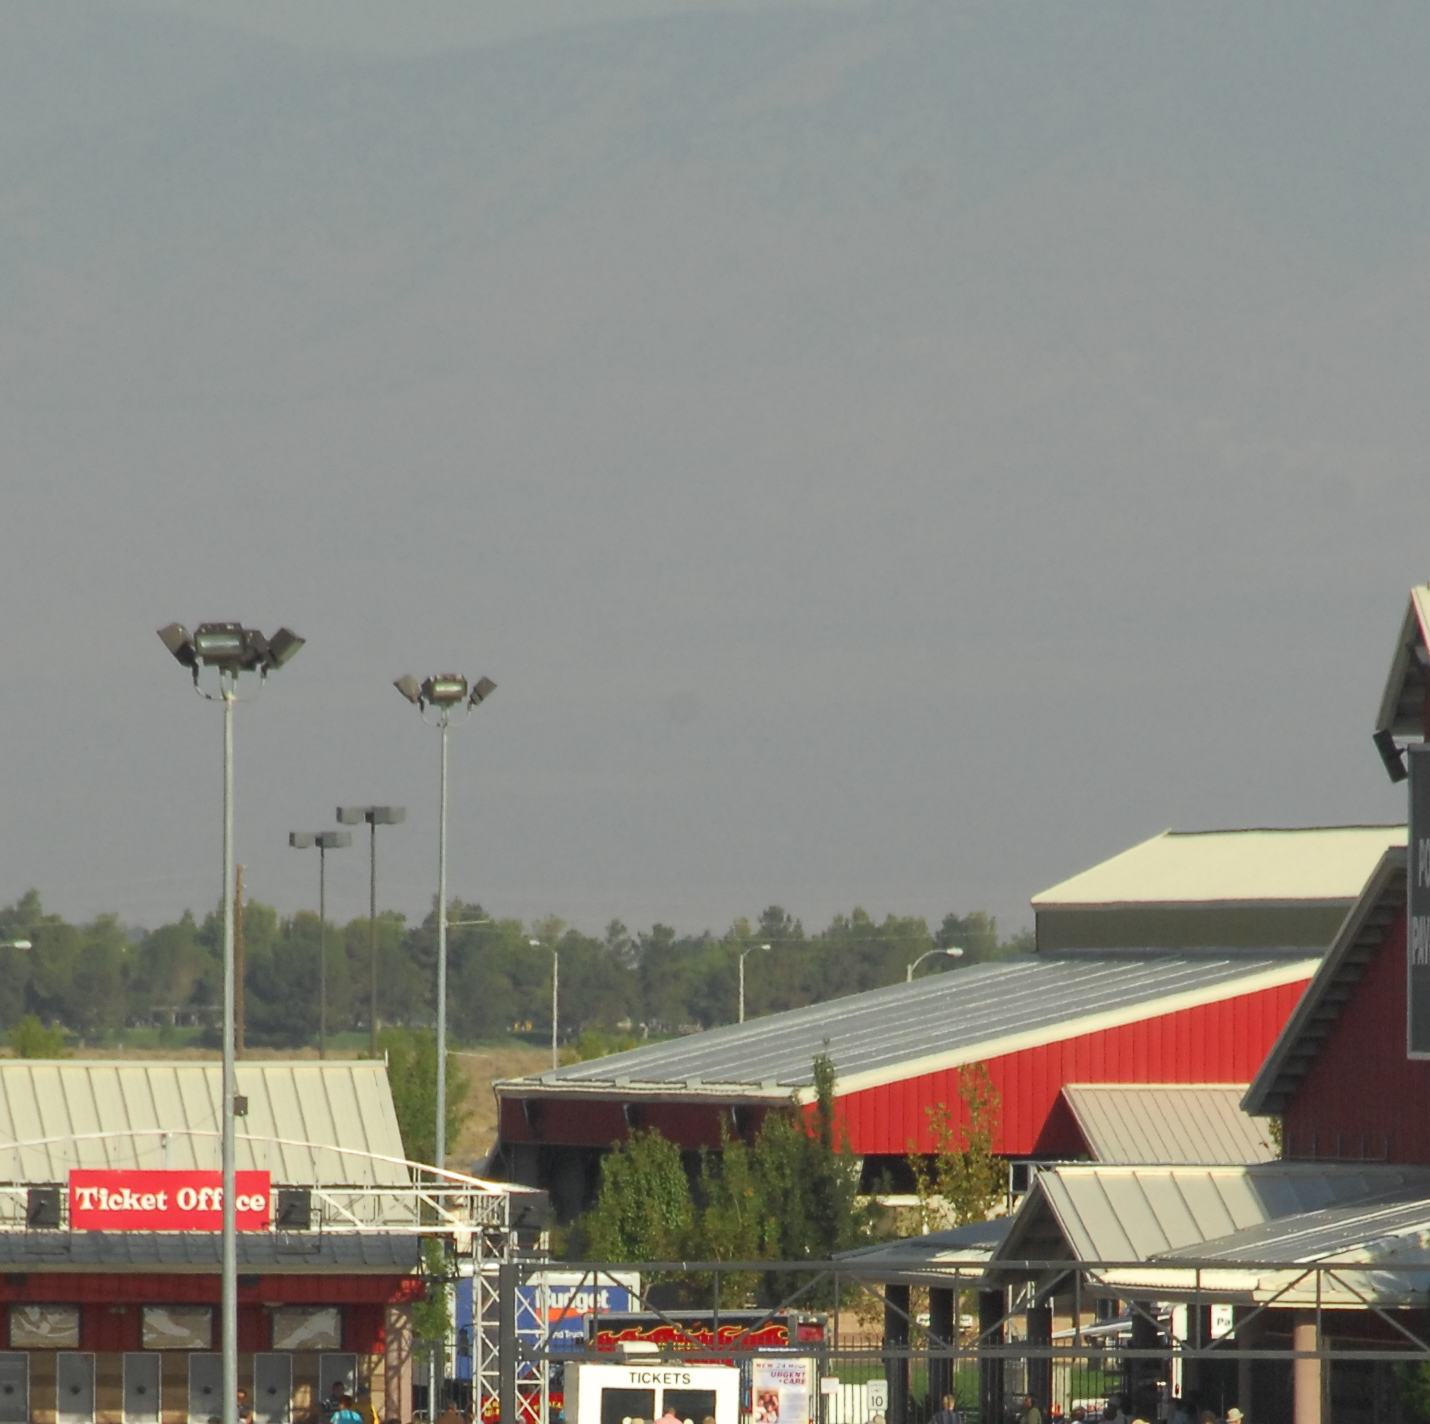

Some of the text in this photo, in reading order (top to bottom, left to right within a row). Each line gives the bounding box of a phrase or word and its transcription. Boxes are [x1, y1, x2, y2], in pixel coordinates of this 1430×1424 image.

[75, 1186, 266, 1212] Ticket Offce
[536, 1286, 609, 1314] Budget
[629, 1371, 691, 1385] TICKETS
[871, 1395, 884, 1407] 10
